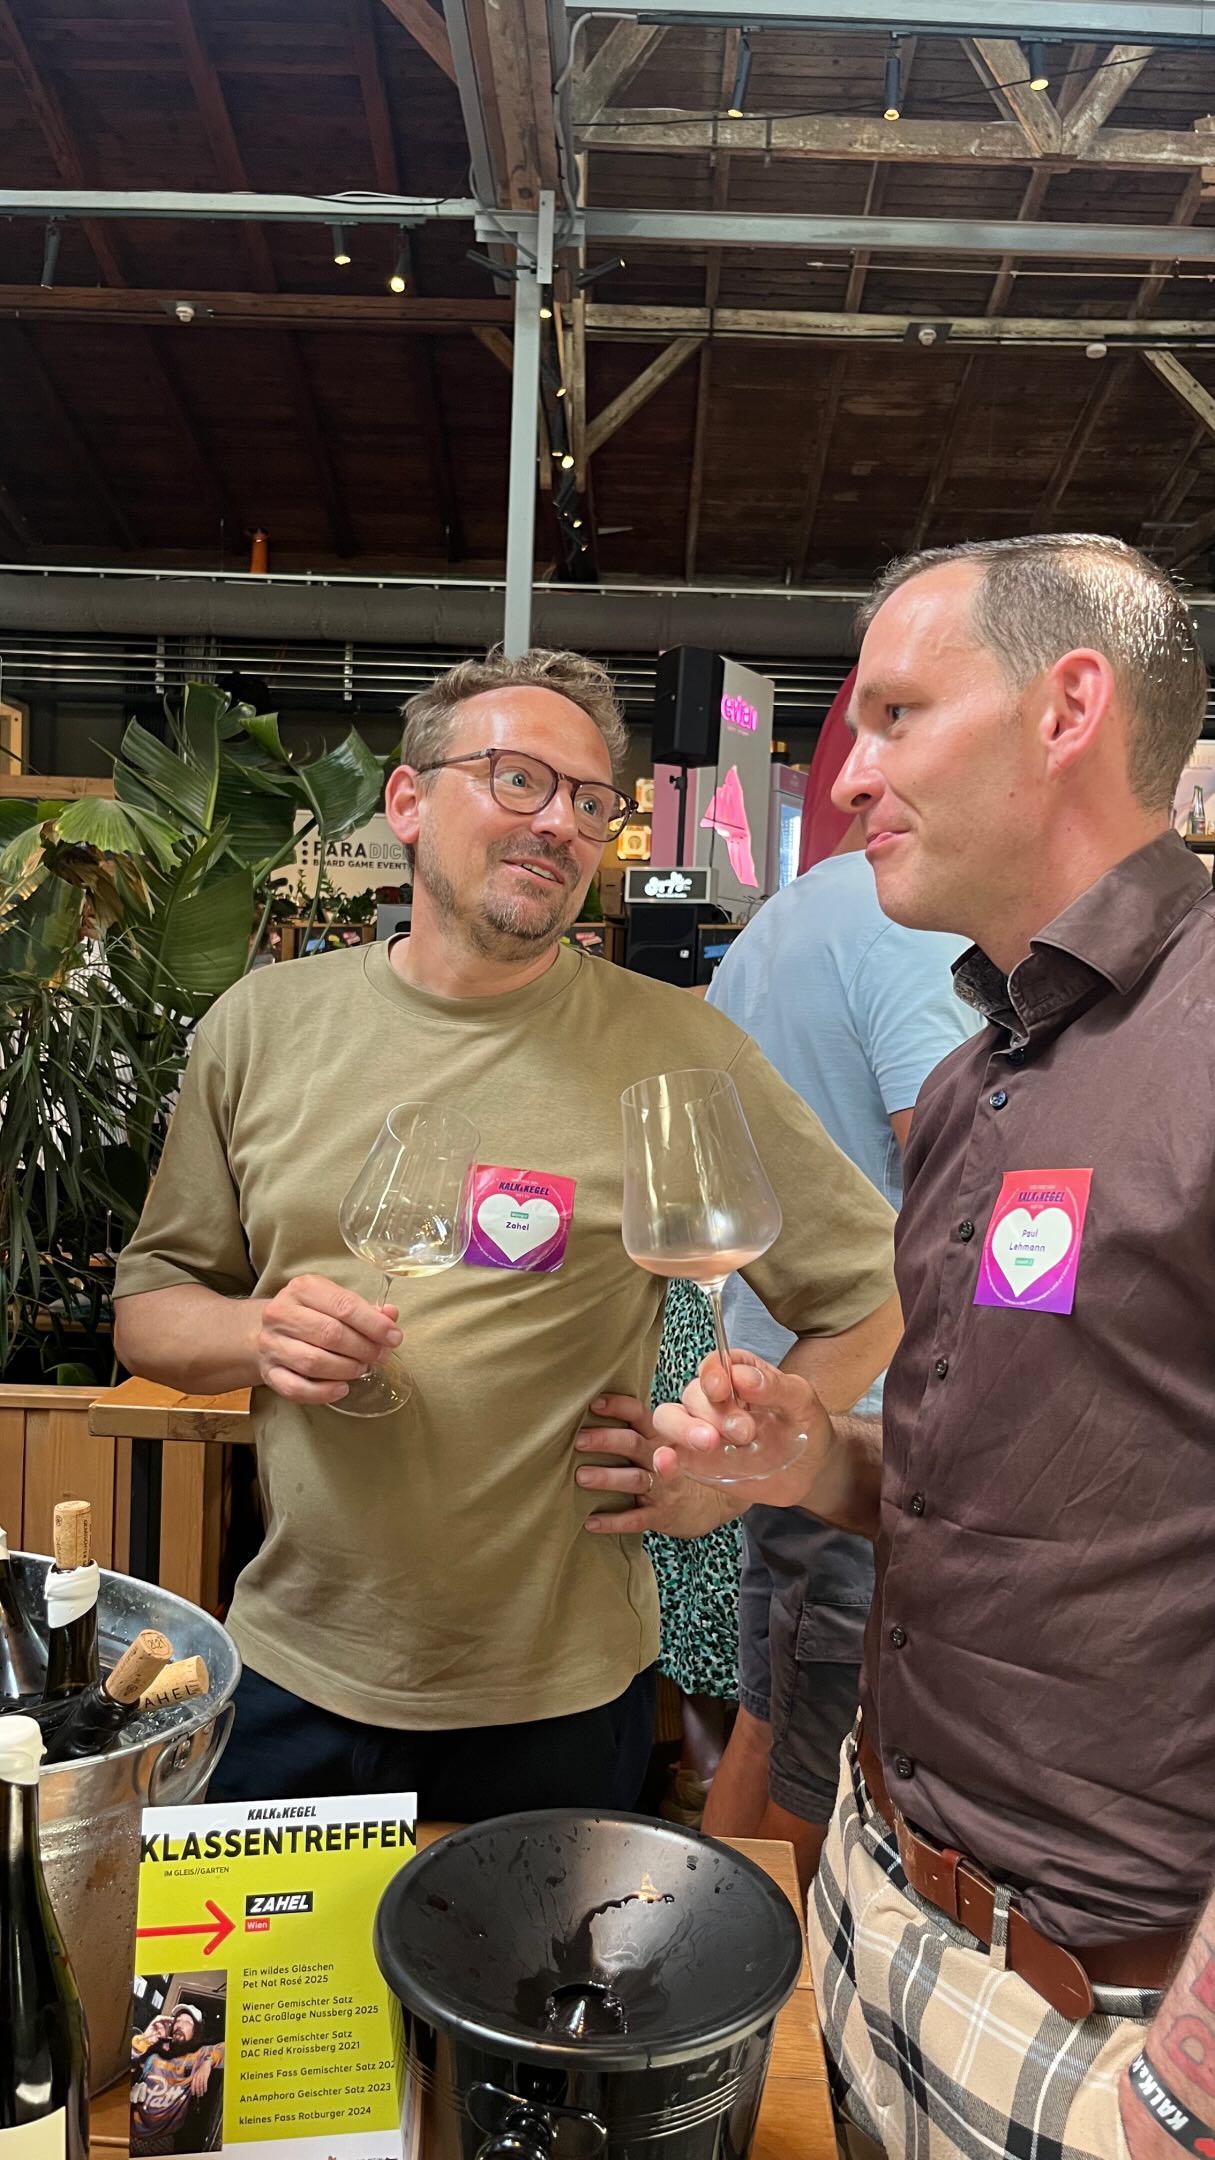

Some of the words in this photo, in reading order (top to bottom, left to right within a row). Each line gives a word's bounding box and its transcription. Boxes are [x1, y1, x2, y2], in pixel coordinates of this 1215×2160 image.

[313, 859, 345, 868] BARD
[348, 860, 374, 869] GAME
[377, 861, 407, 870] EVENT
[506, 1221, 529, 1231] Zahel
[1022, 1229, 1038, 1237] Paul
[1009, 1242, 1045, 1252] Lehmann
[144, 1681, 200, 1709] AHEL
[247, 1805, 317, 1820] KALK&KEGEL
[140, 1819, 417, 1863] KLASSENTREFFEN
[174, 1866, 230, 1876] GLEIS//GARTEN
[250, 1895, 309, 1913] ZAHEL
[247, 1921, 268, 1930] Wien
[243, 1968, 257, 1977] Ein
[260, 1965, 289, 1975] wildes
[292, 1963, 334, 1973] Gläschen
[243, 1980, 258, 1989] Pet
[261, 1979, 277, 1988] Nat
[280, 1976, 302, 1986] Rosé
[304, 1975, 328, 1984] 2025
[242, 2001, 274, 2011] Wiener
[277, 1997, 330, 2009] Gemischter
[332, 1995, 353, 2005] Satz
[242, 2014, 261, 2024] DAC
[264, 2011, 307, 2022] Großlage
[309, 2008, 353, 2019] Nussberg
[355, 2005, 379, 2014] 2025
[241, 2037, 273, 2046] Wiener
[276, 2032, 330, 2044] Gemischter
[332, 2030, 352, 2040] Satz
[240, 2049, 260, 2059] DAC
[263, 2047, 284, 2056] Ried
[286, 2043, 336, 2055] Kroissberg
[338, 2040, 360, 2050] 2021
[240, 2070, 274, 2081] Kleines
[276, 2069, 298, 2078] Fass
[300, 2064, 352, 2076] Gemischter
[355, 2062, 376, 2072] Satz
[378, 2060, 395, 2070] 202
[239, 2092, 295, 2103] AnAmphora
[297, 2087, 342, 2099] Geischter
[344, 2085, 365, 2094] Satz
[367, 2082, 391, 2093] 2023
[239, 2115, 272, 2125] kleines
[274, 2113, 296, 2122] Fass
[298, 2108, 346, 2120] Rotburger
[347, 2106, 371, 2116] 2024
